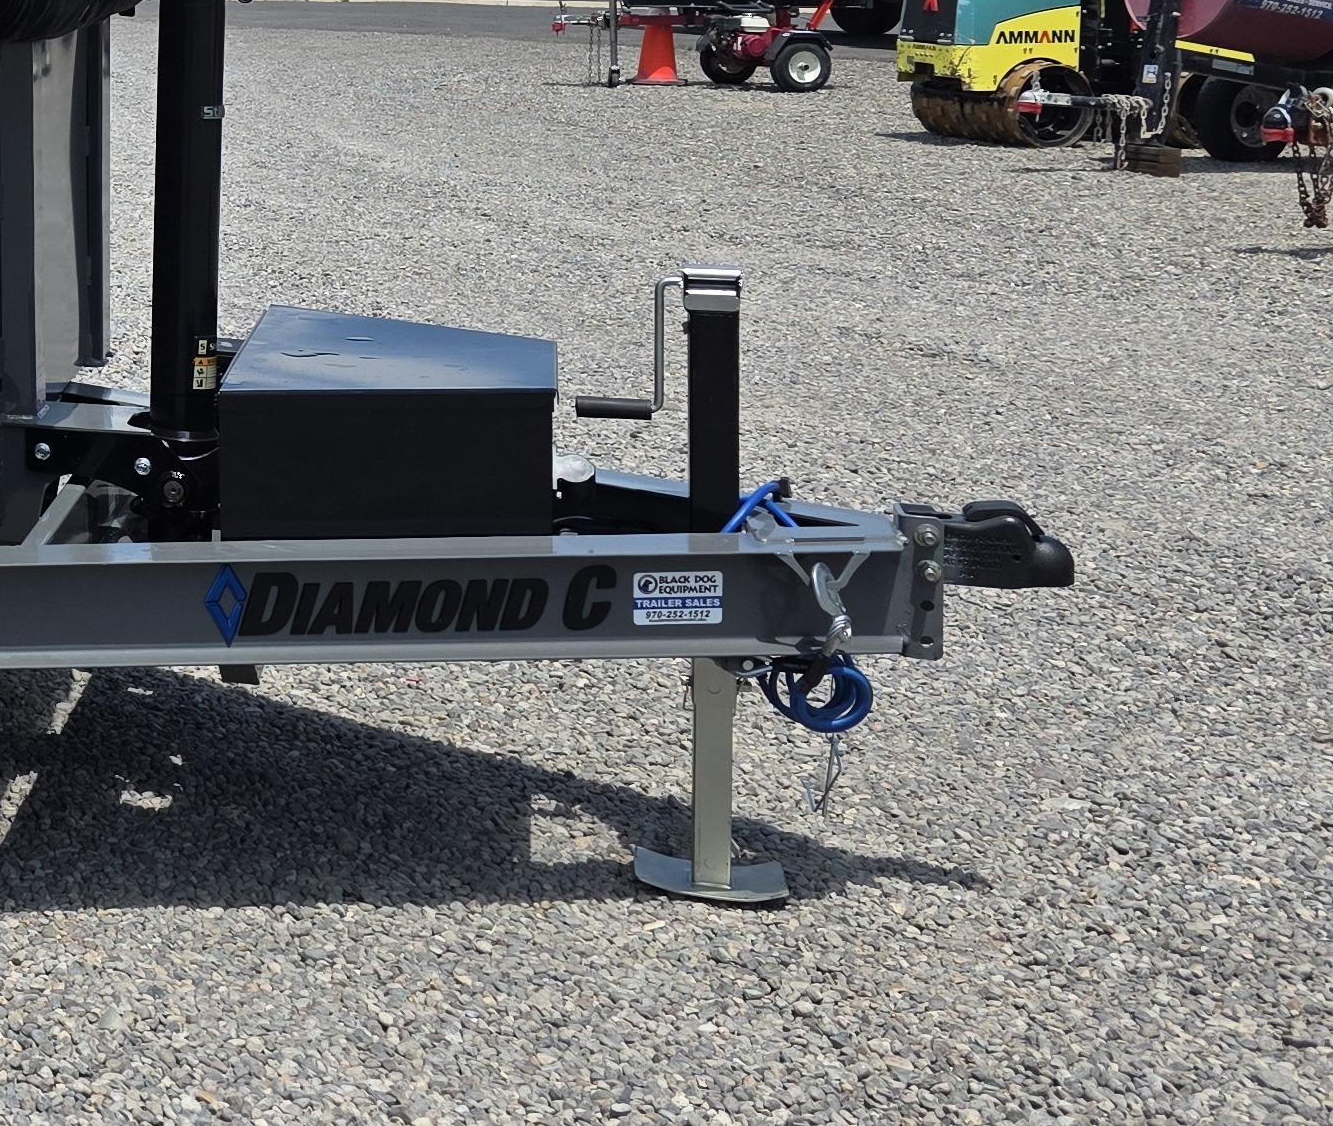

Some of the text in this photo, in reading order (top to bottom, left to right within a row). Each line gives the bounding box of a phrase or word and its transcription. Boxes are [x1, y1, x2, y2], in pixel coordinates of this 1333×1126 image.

[1260, 0, 1324, 20] 970-252-1512
[996, 30, 1075, 44] AMMANN
[659, 575, 717, 584] BLACK DOG
[659, 585, 719, 595] EQUIPMENT
[238, 564, 617, 637] DIAMOND C
[635, 599, 720, 608] TRAILER SALES
[645, 610, 711, 619] 970-252-1512
